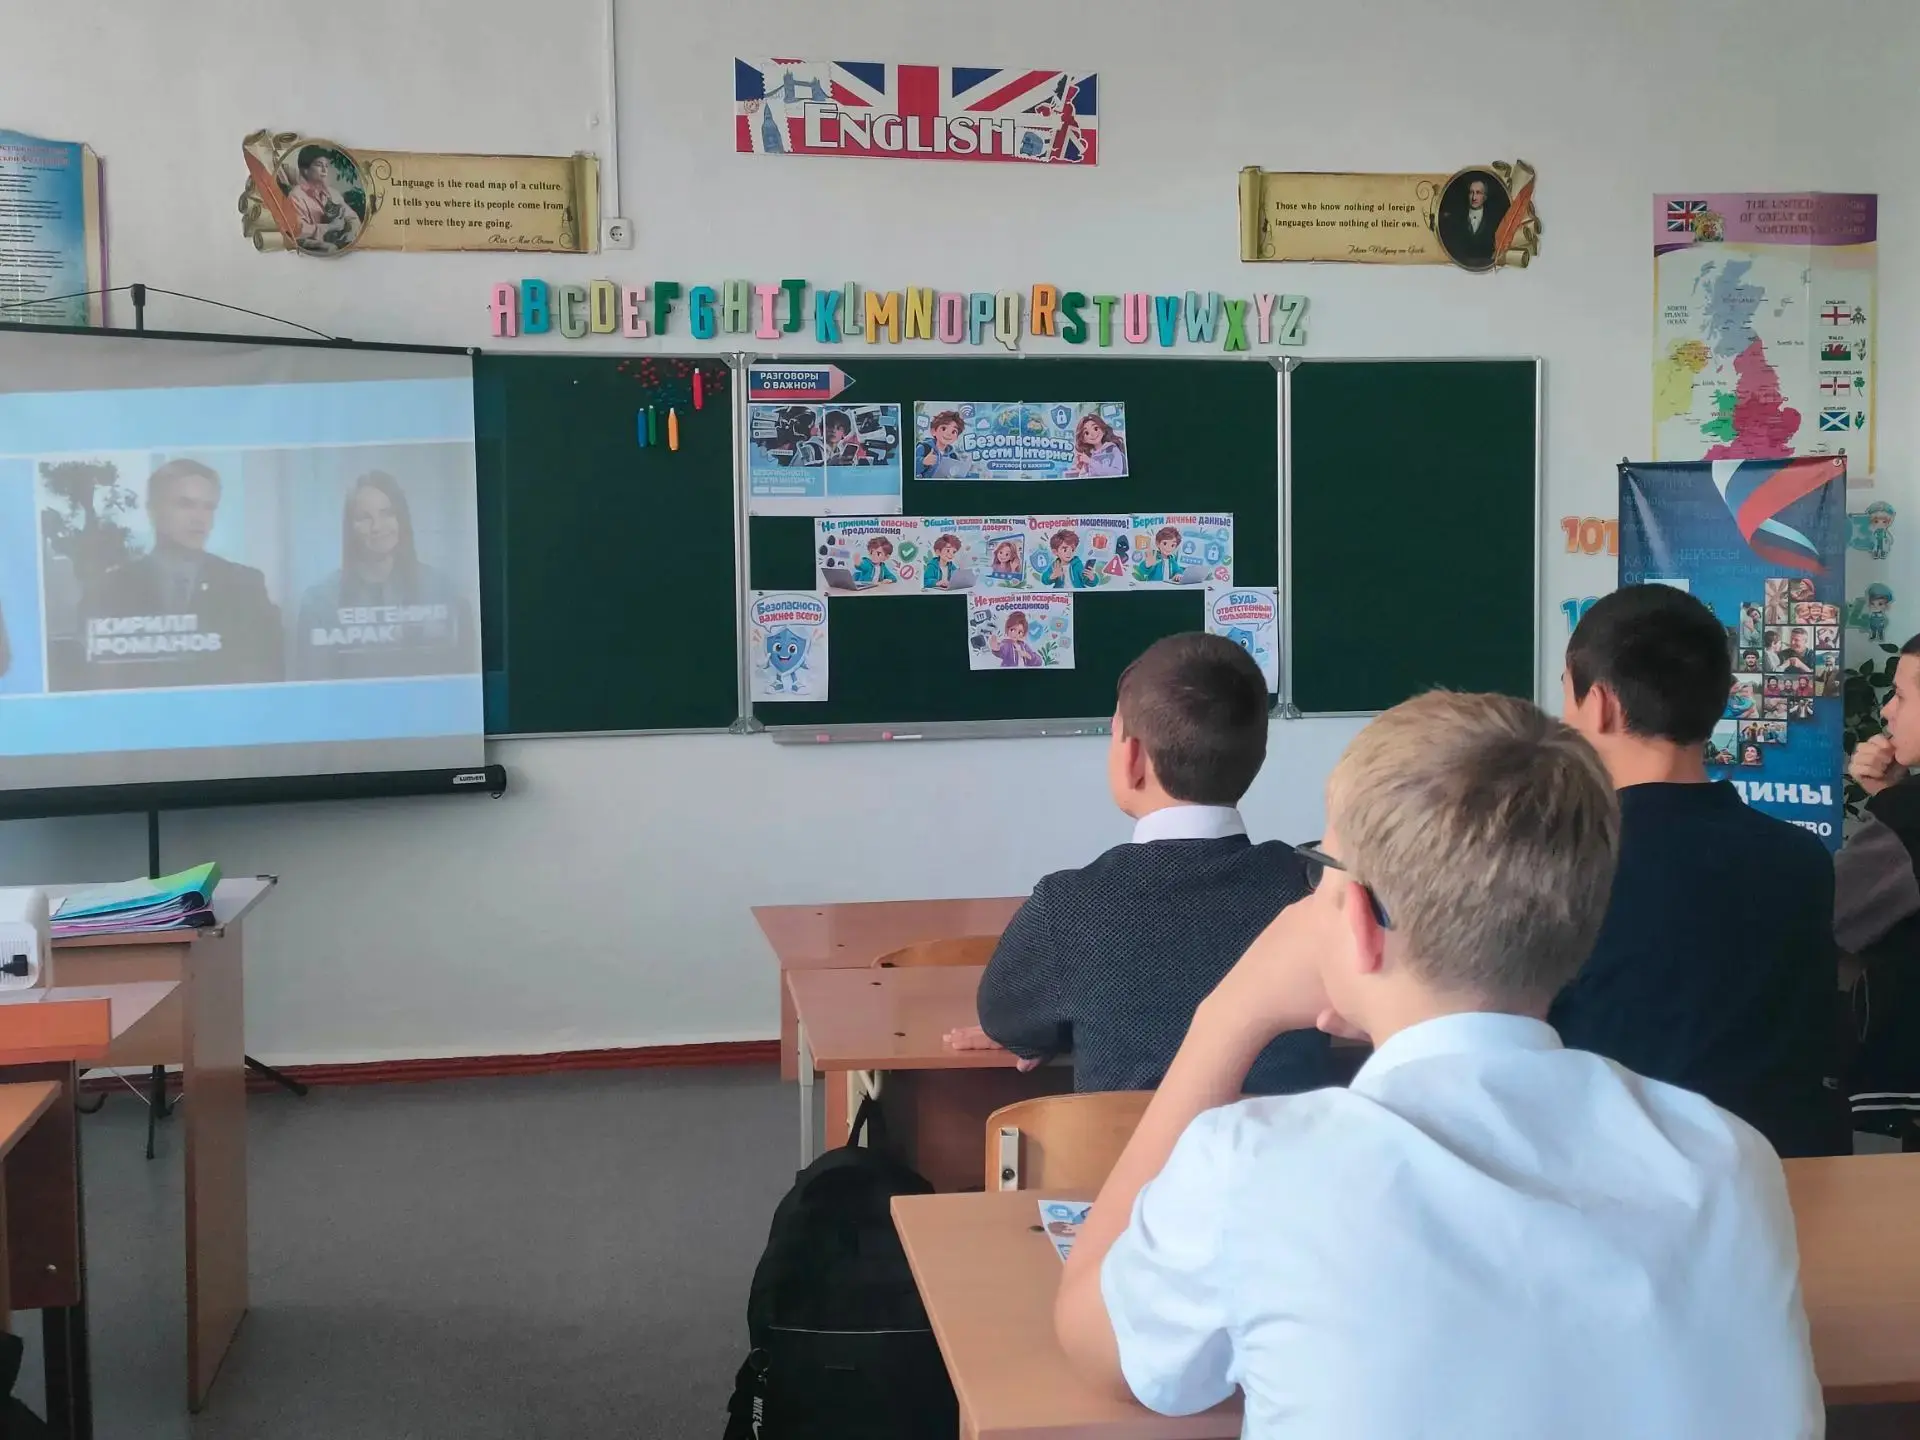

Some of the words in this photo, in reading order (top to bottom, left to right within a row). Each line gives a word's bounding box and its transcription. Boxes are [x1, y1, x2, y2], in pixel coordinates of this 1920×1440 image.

[803, 101, 1017, 156] ENGLISH
[391, 178, 435, 188] Language
[437, 178, 445, 188] is
[448, 179, 462, 189] the
[465, 180, 485, 189] road
[488, 182, 507, 191] map
[509, 181, 518, 190] of
[528, 181, 563, 191] culture.
[392, 197, 401, 207] It
[403, 198, 422, 208] tells
[425, 200, 441, 210] you
[444, 199, 471, 208] where
[474, 199, 485, 209] its
[487, 201, 515, 212] people
[517, 202, 540, 210] come
[543, 201, 564, 211] from
[1276, 201, 1298, 211] Those
[1301, 201, 1317, 211] who
[1320, 201, 1340, 211] know
[1344, 201, 1374, 213] nothing
[1377, 202, 1386, 211] of
[1388, 202, 1416, 213] foreign
[1746, 200, 1769, 210] THE
[393, 217, 410, 226] and
[416, 218, 443, 227] where
[446, 218, 466, 229] they
[468, 219, 483, 228] are
[485, 219, 513, 231] going.
[1275, 218, 1314, 229] languages
[1316, 218, 1336, 228] know
[1339, 219, 1369, 230] nothing
[1371, 219, 1378, 228] of
[1381, 219, 1400, 229] their
[1401, 221, 1420, 229] own.
[1740, 213, 1754, 223] OF
[1758, 213, 1795, 223] GREAT
[760, 372, 819, 381] РАЗГОВОРЫ
[763, 381, 770, 389] О
[773, 381, 816, 390] ВАЖНОМ
[963, 433, 1074, 452] Безопасность
[972, 450, 981, 461] в
[982, 447, 1012, 459] сети
[1014, 446, 1074, 462] Интернет
[821, 520, 836, 533] Не
[838, 518, 879, 529] принимай
[881, 519, 918, 529] опасные
[1080, 518, 1129, 530] мошенников!
[1132, 515, 1164, 530] Береги
[1198, 517, 1231, 527] данные
[841, 527, 901, 537] предложения
[974, 595, 988, 607] Не
[756, 601, 822, 615] Безопасность
[759, 611, 794, 624] важнее
[795, 611, 822, 622] всего!
[95, 632, 222, 656] РОМАНОВ
[752, 1395, 763, 1422] NIKE
